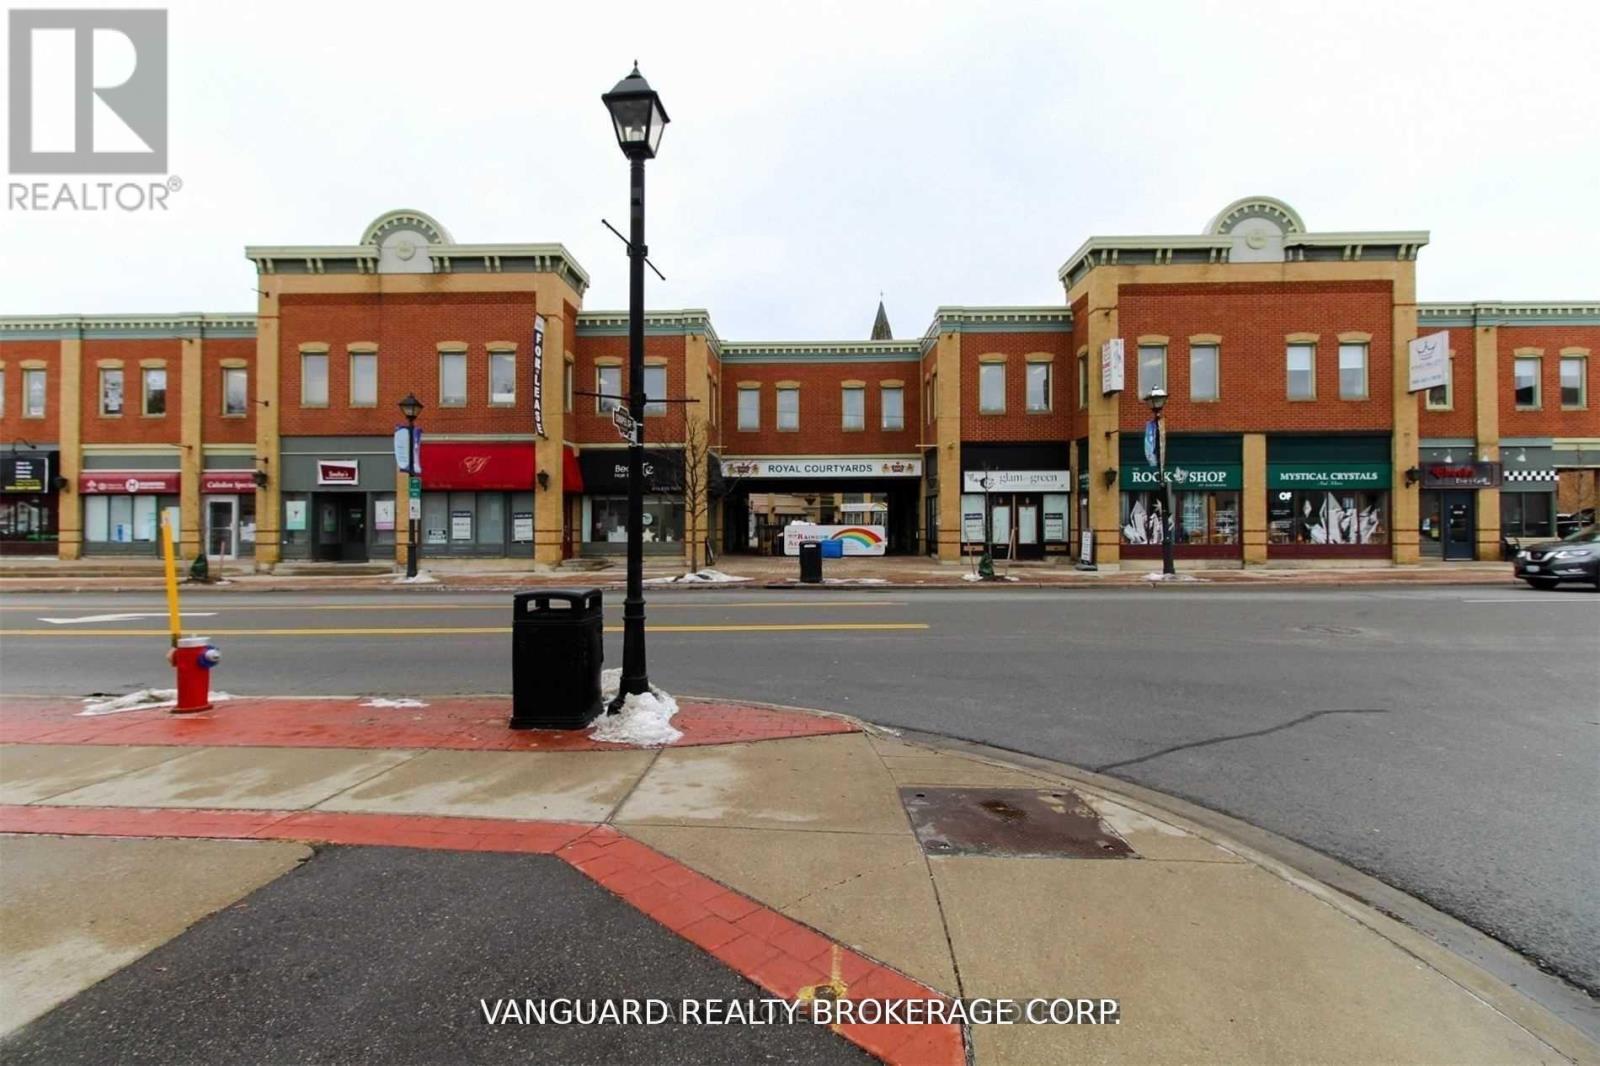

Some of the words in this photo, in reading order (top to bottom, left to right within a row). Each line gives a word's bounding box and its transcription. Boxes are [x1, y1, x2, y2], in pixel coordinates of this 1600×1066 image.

[534, 374, 544, 434] LEASE
[768, 464, 802, 473] ROYAL
[804, 464, 873, 473] COURTYARDS
[1030, 474, 1058, 484] green
[1132, 471, 1173, 482] ROCK
[1189, 471, 1227, 482] SHOP
[1280, 472, 1328, 481] MYSTICAL
[1330, 472, 1378, 480] CRYSTALS
